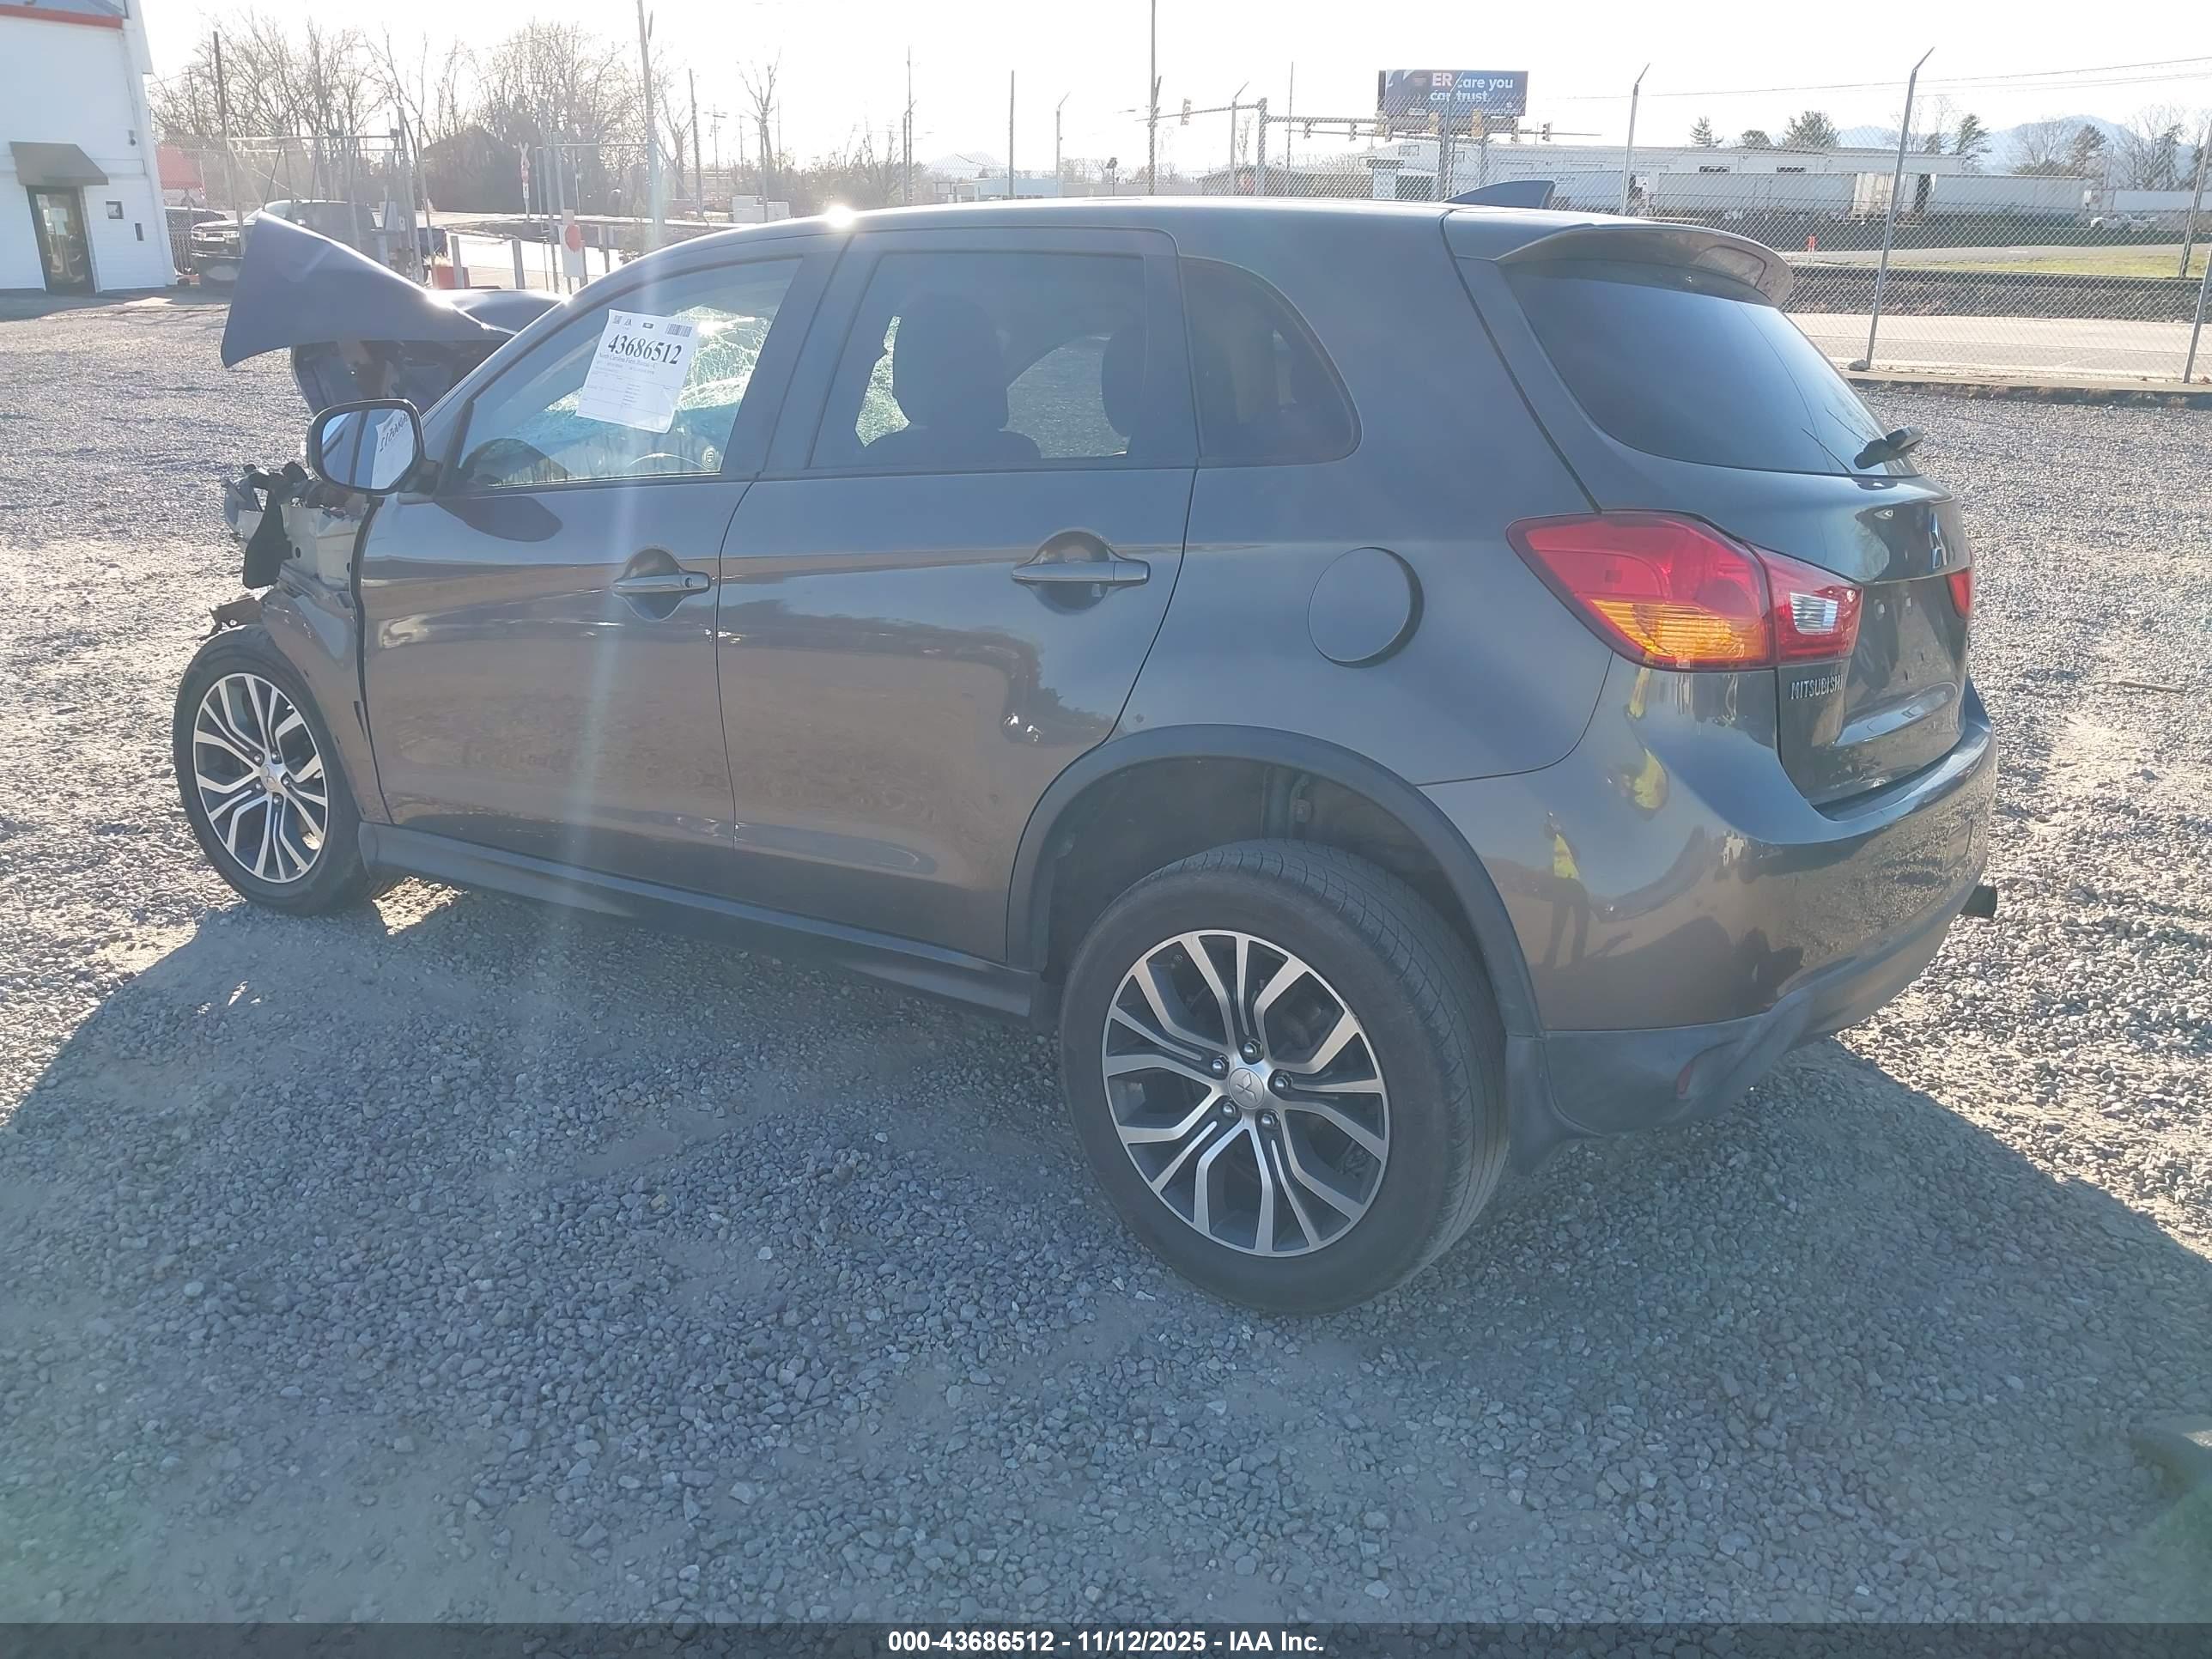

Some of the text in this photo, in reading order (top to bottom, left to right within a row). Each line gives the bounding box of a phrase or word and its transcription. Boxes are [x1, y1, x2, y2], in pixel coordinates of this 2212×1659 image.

[1432, 73, 1452, 87] ER
[1489, 78, 1513, 91] you
[608, 334, 683, 364] 43686512
[1790, 674, 1844, 700] MITSUBISHI
